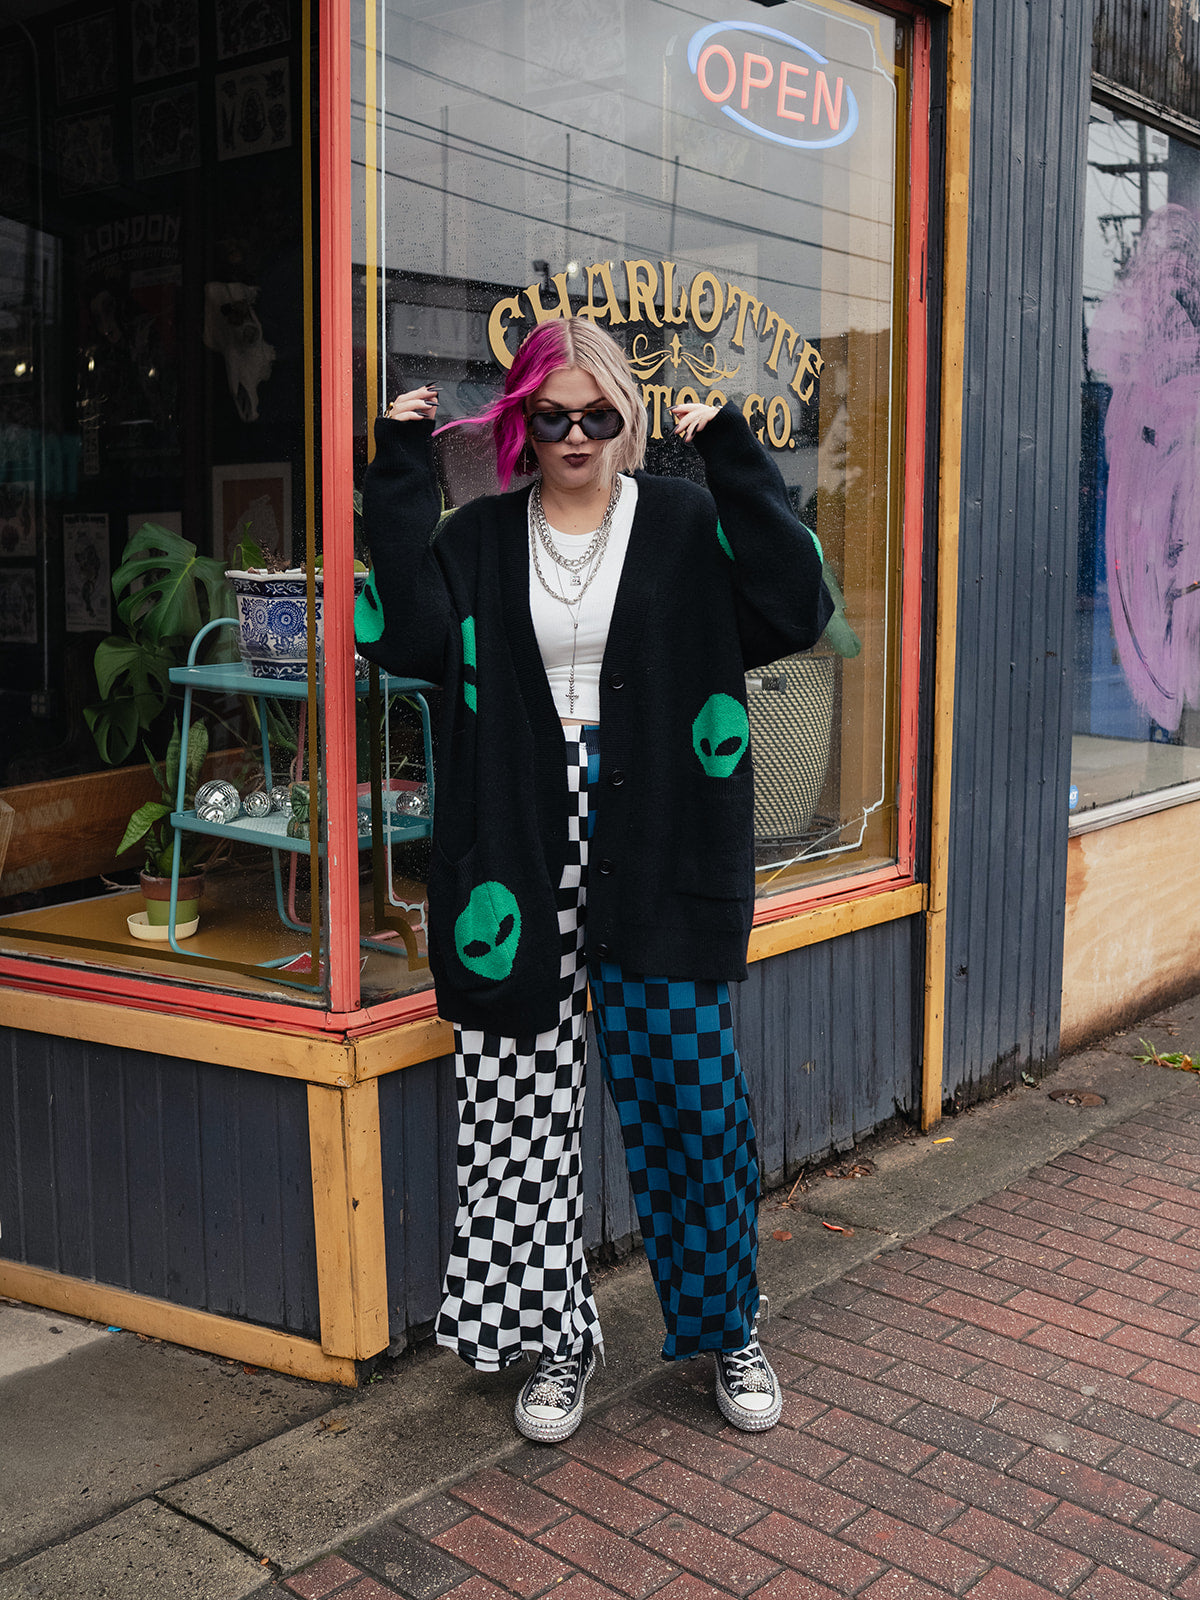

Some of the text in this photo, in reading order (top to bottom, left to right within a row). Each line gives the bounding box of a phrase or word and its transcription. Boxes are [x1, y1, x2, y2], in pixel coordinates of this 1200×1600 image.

[697, 44, 843, 130] OPEN
[83, 215, 180, 257] LONDON
[488, 259, 825, 405] CHARLOTTE
[742, 393, 795, 449] CO.
